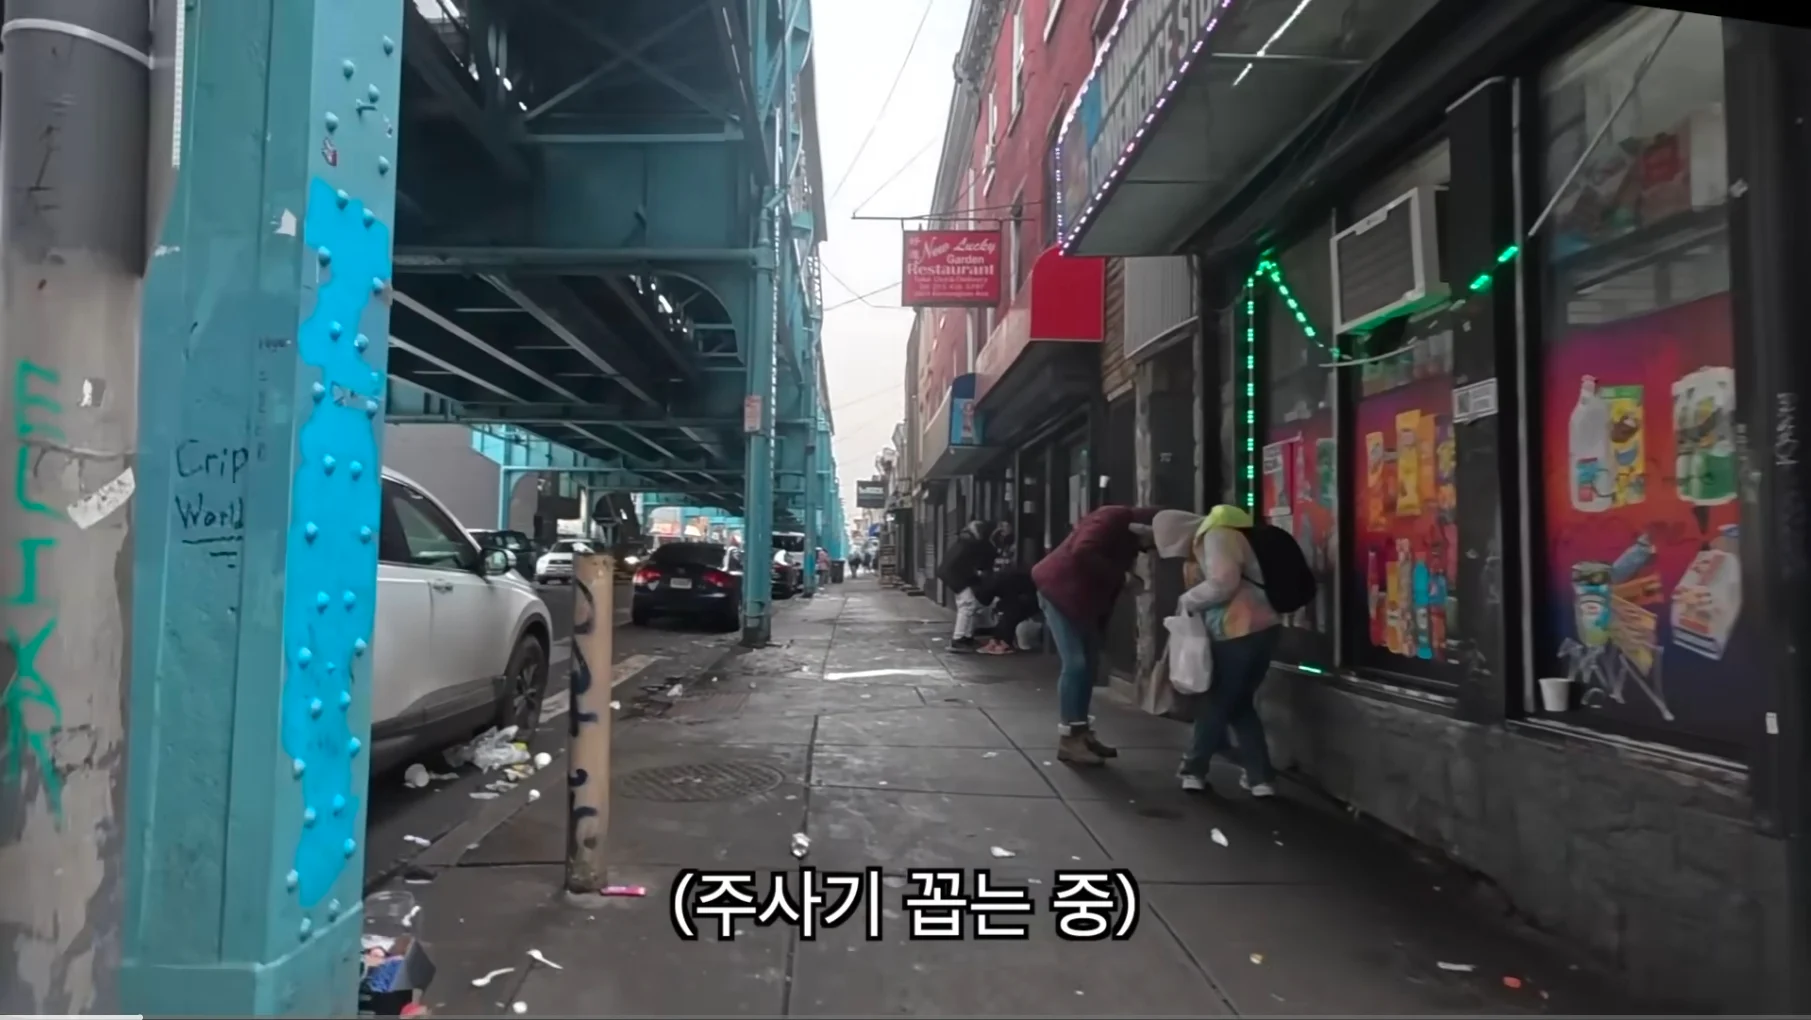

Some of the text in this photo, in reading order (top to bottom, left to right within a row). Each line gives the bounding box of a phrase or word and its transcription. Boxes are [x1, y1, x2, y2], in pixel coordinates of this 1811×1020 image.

[919, 237, 950, 261] New
[953, 237, 996, 254] Lucky
[946, 253, 985, 264] Garden
[907, 263, 994, 276] Restaurant
[176, 438, 249, 484] Crip
